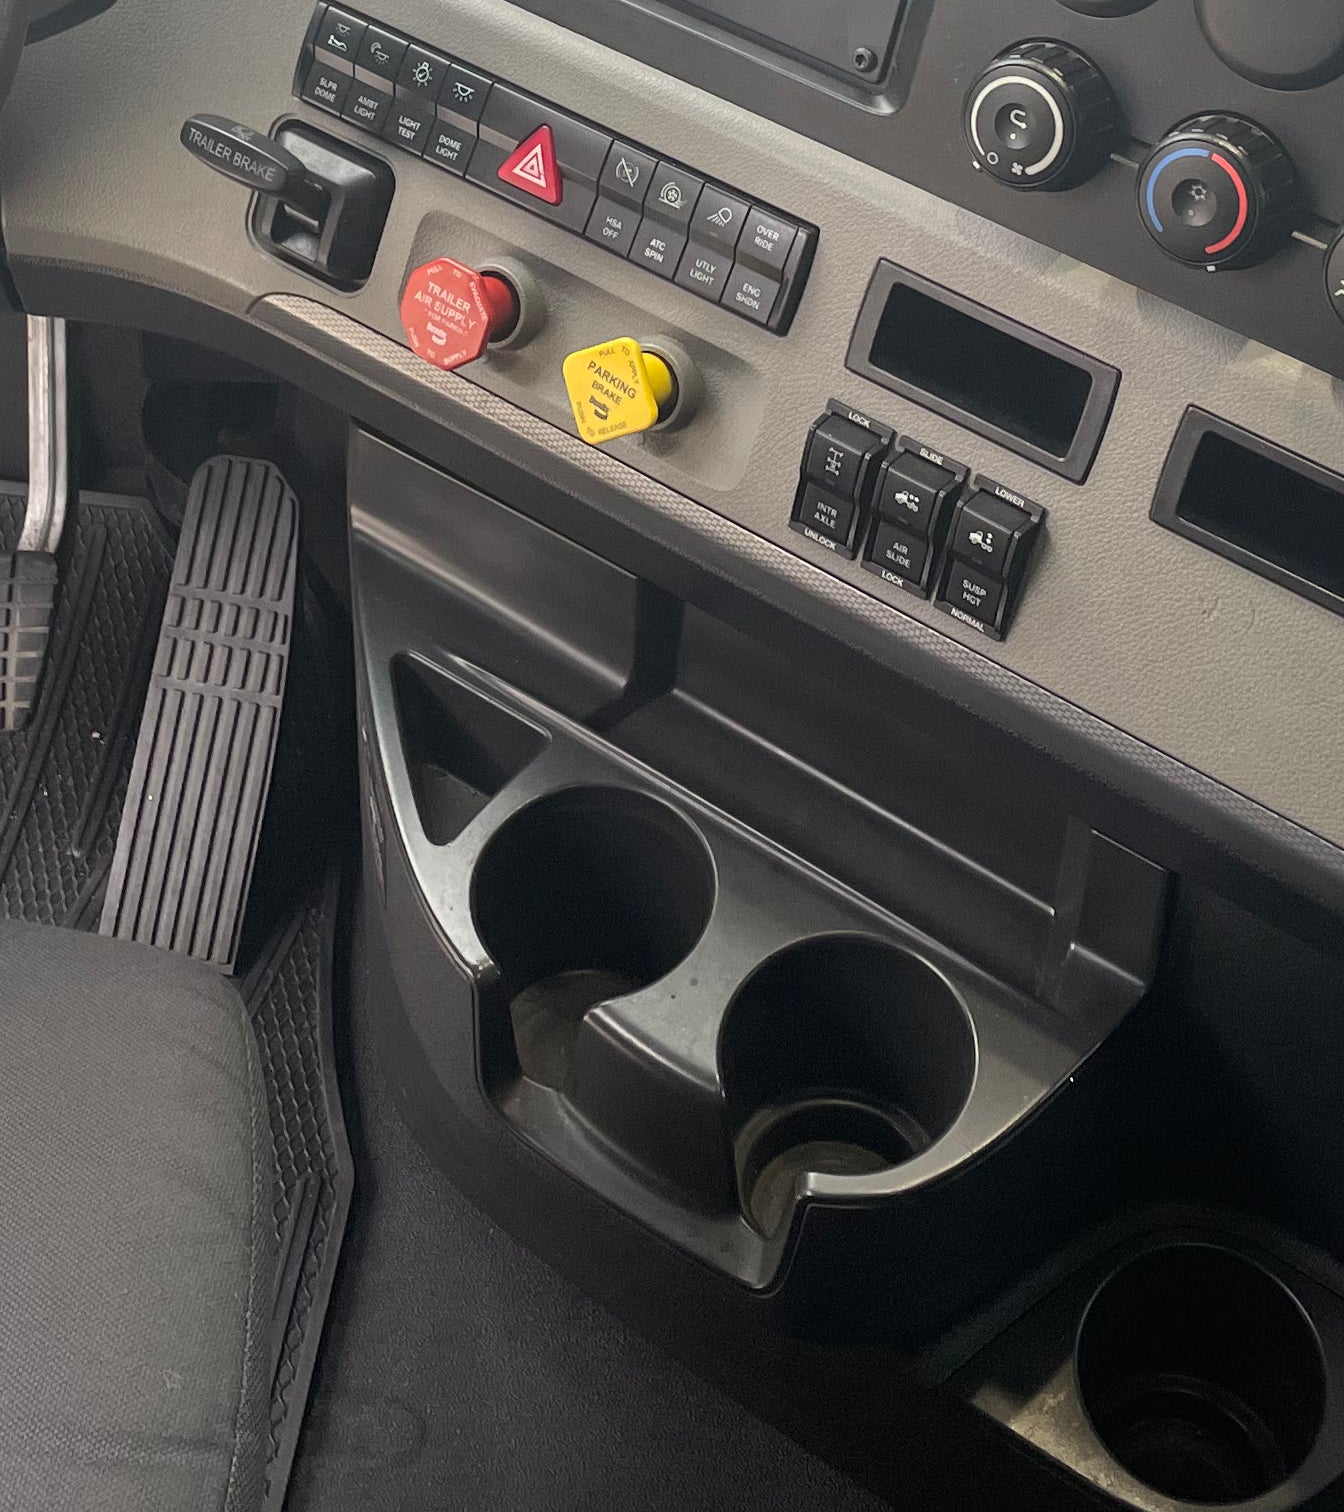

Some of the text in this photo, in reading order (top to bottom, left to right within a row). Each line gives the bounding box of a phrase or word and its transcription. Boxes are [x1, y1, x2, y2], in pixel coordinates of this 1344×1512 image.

[319, 77, 338, 92] SLPR
[314, 88, 336, 103] DOME
[354, 105, 376, 120] LIGHT
[399, 115, 421, 131] LIGHT
[397, 126, 416, 140] TEST
[438, 134, 462, 151] DOME
[188, 127, 276, 182] TRAILER BRAKE
[436, 145, 458, 161] LIGHT
[606, 216, 622, 230] HSA
[602, 227, 619, 239] OFF
[756, 225, 780, 242] OVER
[650, 238, 666, 252] ATC
[754, 236, 775, 252] RIDE
[644, 248, 664, 263] SPIN
[696, 258, 717, 274] UTLY
[690, 269, 714, 286] LIGHT
[428, 281, 471, 313] TRAILER
[743, 283, 761, 298] ENG
[736, 292, 760, 310] SHDN
[414, 291, 476, 330] AIR SUPPLY
[587, 360, 637, 399] PARKING
[592, 380, 622, 405] BRAKE
[598, 421, 627, 435] RELEASE
[848, 411, 871, 428] LOCK
[919, 447, 944, 465] SLIDE
[995, 486, 1025, 507] LOWER
[817, 501, 837, 518] INTR
[814, 512, 836, 529] AXLE
[804, 527, 837, 550] UNLOCK
[892, 542, 908, 555] AIR
[885, 550, 911, 568] SLIDE
[881, 569, 904, 587] LOCK
[962, 579, 987, 596] SUSP
[962, 591, 982, 607] HGT
[950, 607, 985, 633] NORMAL
